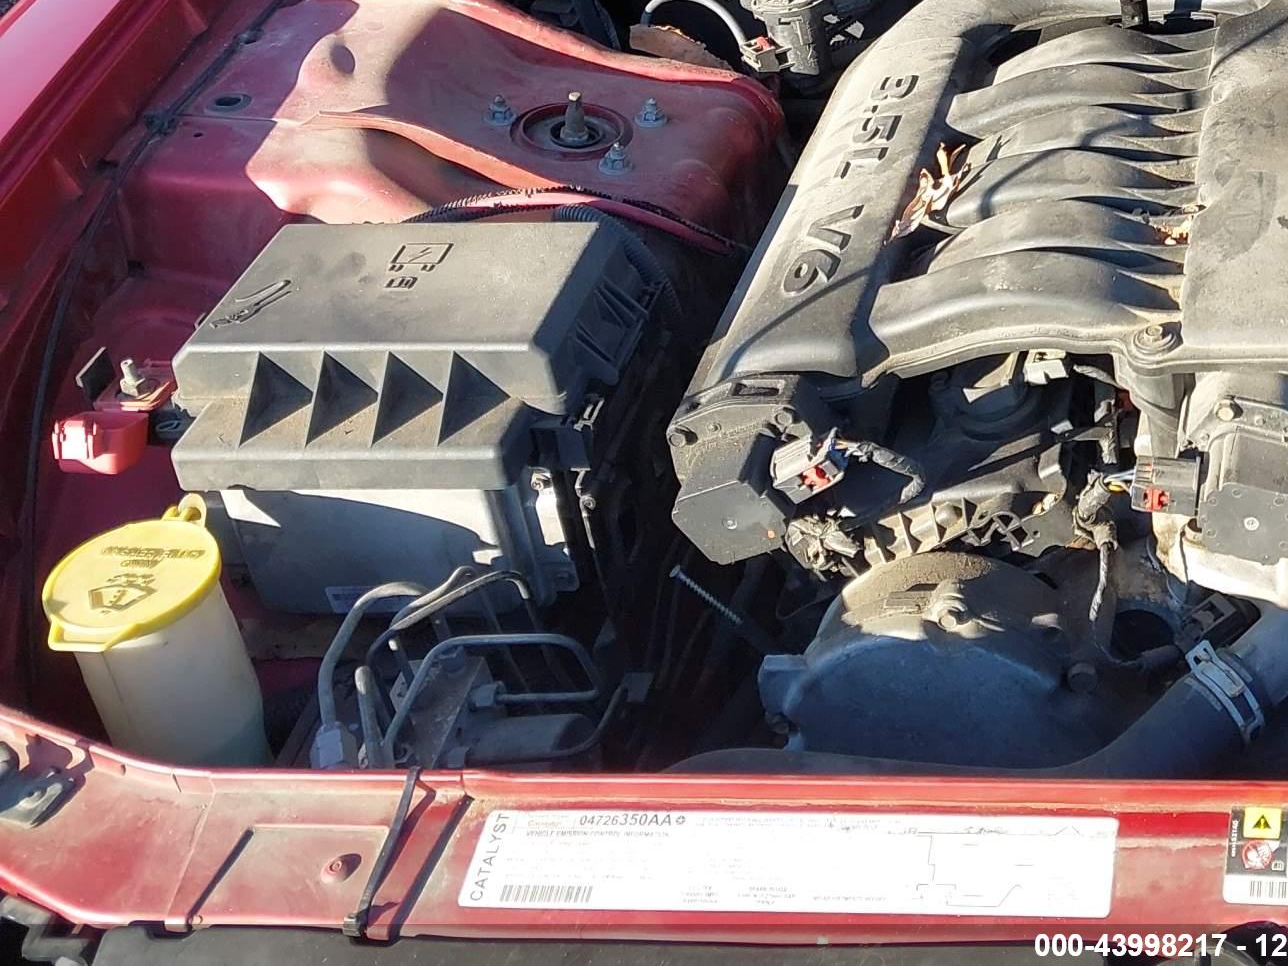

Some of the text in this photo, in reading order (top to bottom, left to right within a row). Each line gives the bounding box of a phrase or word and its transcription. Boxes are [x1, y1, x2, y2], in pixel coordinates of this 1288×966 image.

[783, 74, 920, 296] 3.5L V6
[470, 813, 510, 902] CATALYST
[579, 813, 673, 827] 04726350AA
